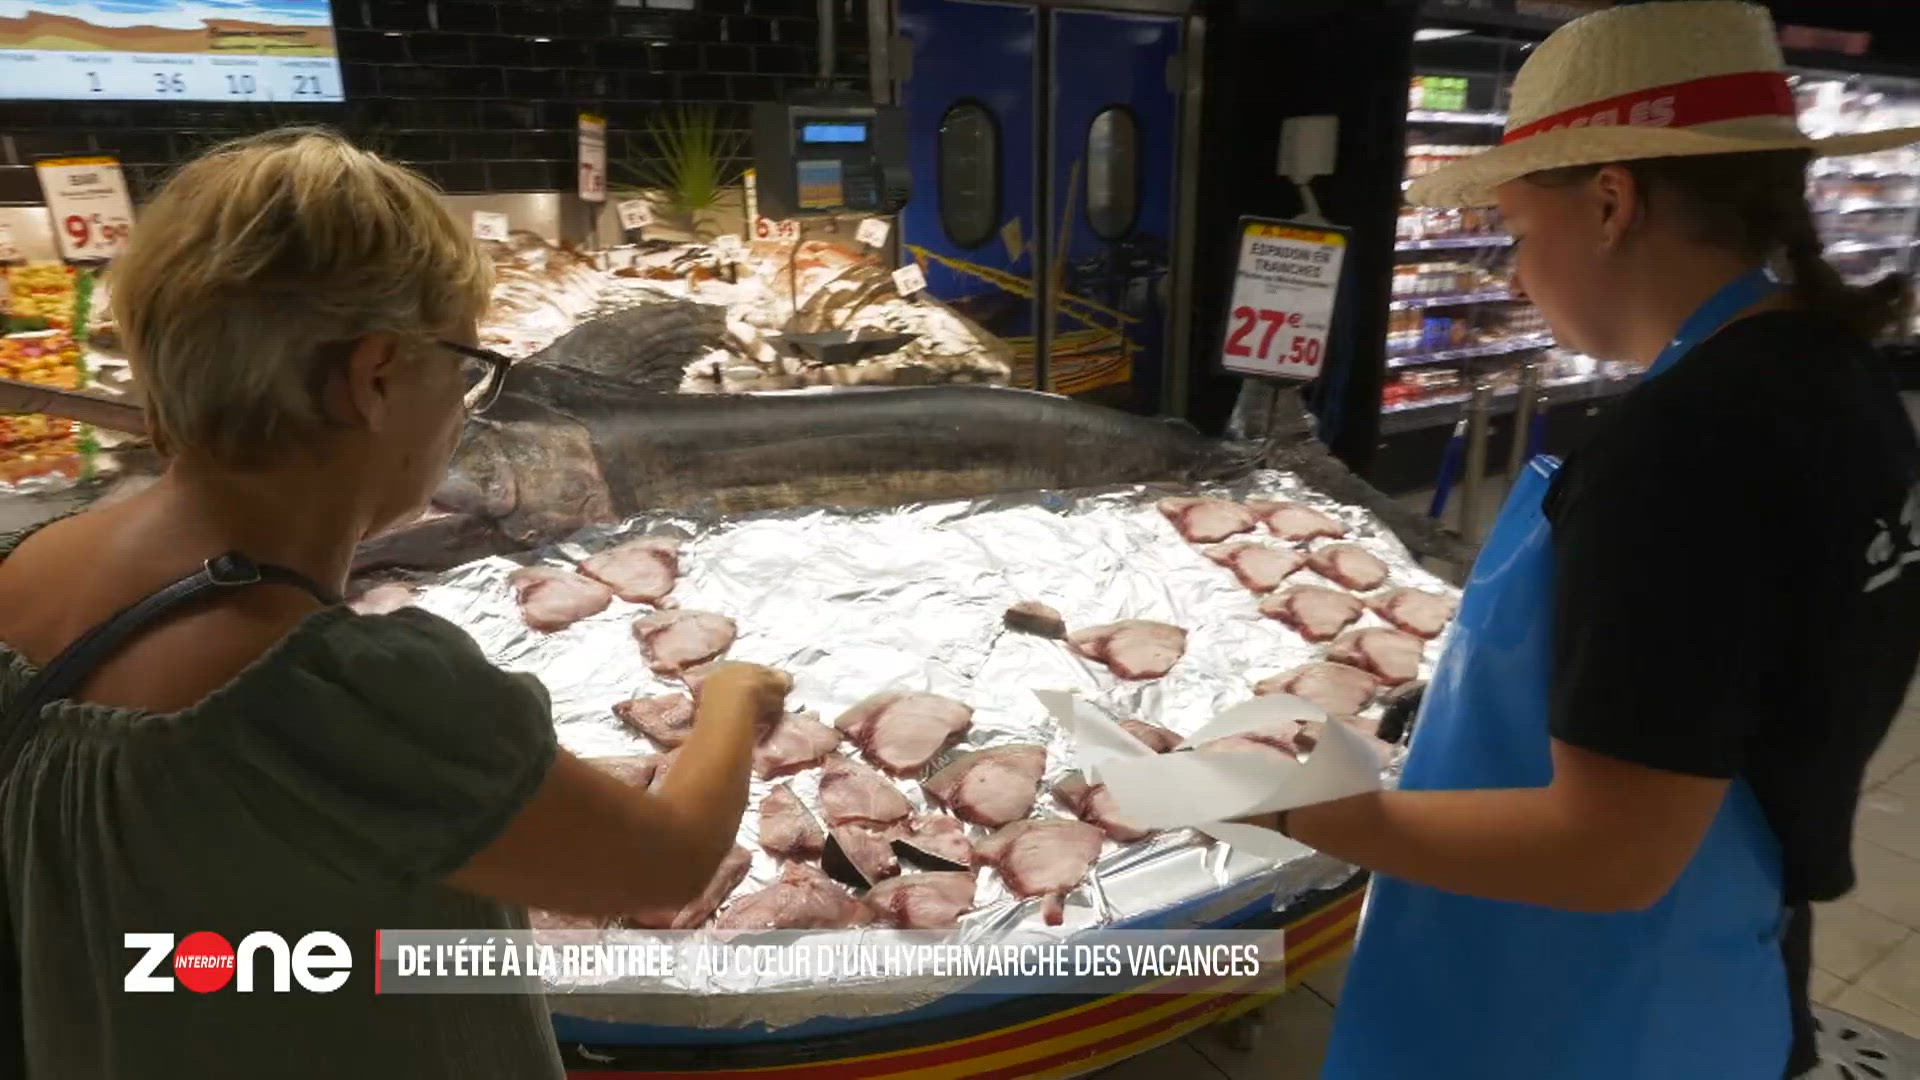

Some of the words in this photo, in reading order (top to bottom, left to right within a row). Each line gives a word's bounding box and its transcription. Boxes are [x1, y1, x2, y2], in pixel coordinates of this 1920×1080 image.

[86, 71, 104, 93] 1
[153, 72, 187, 94] 36
[225, 74, 257, 95] 10
[292, 74, 323, 96] 21
